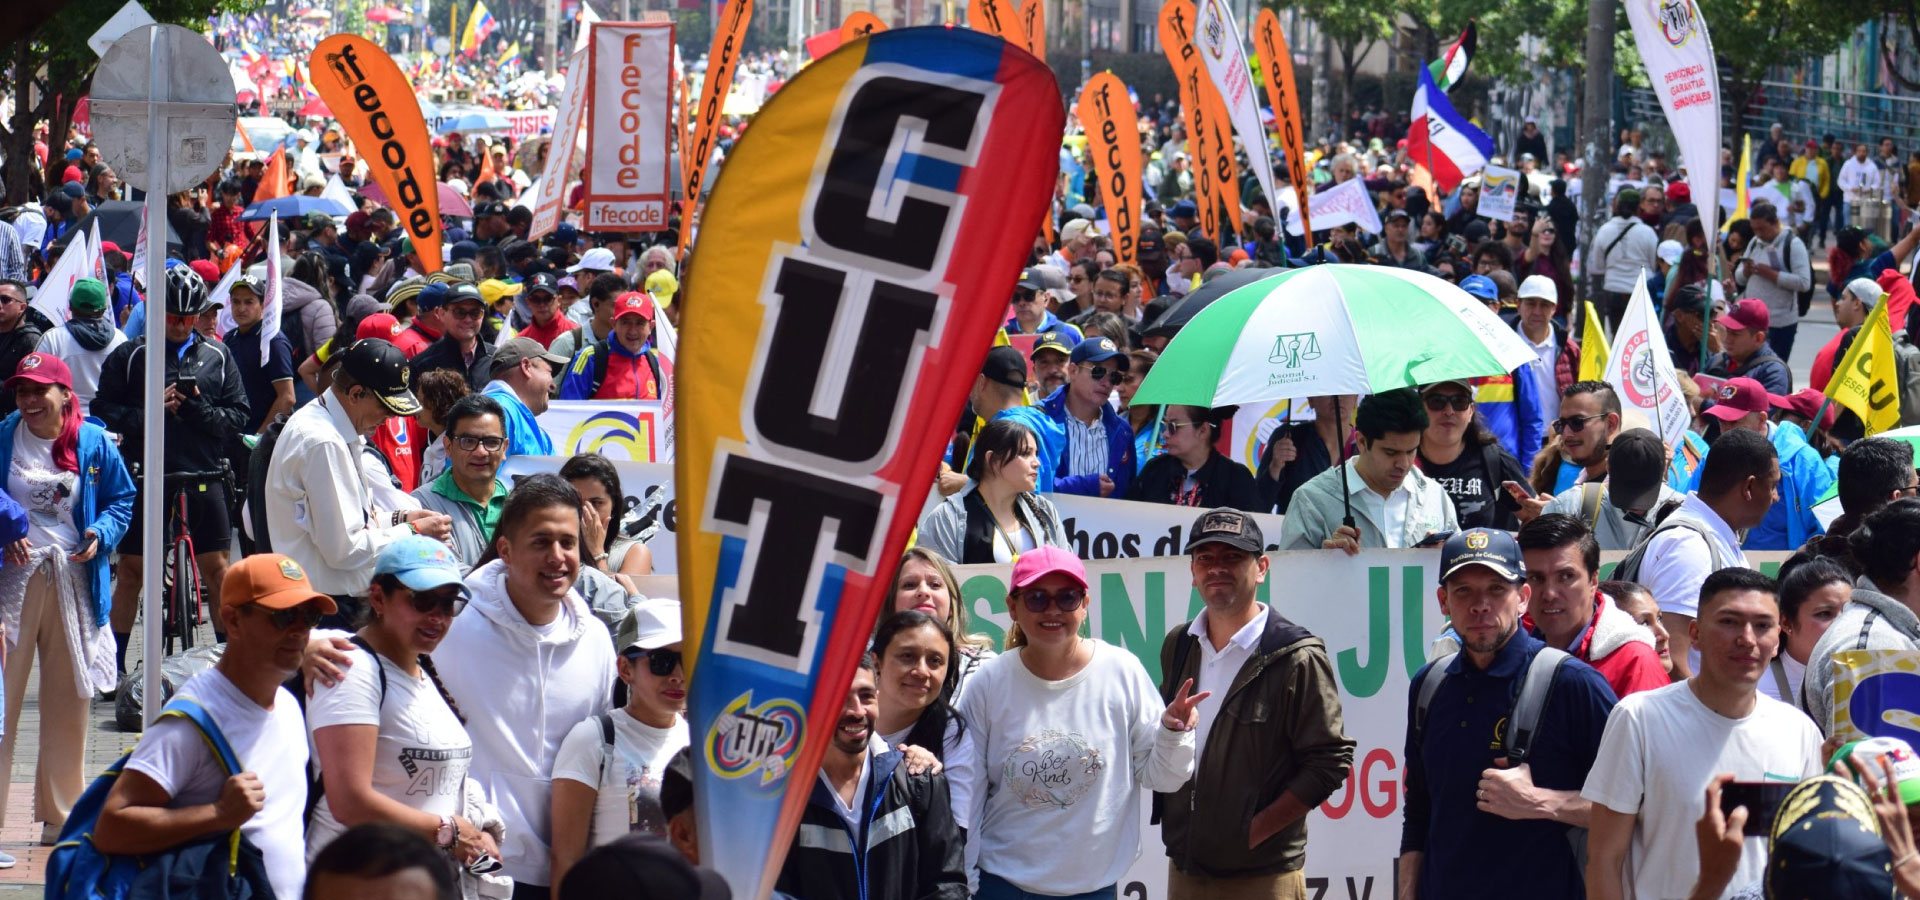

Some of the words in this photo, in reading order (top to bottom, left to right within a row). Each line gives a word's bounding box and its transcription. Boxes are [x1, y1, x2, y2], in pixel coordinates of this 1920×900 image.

[616, 33, 642, 189] fecode
[341, 44, 434, 240] fecode
[1100, 82, 1135, 262] fecode
[600, 203, 660, 224] fecode
[706, 66, 998, 670] CUT
[1266, 377, 1302, 387] Judicial
[1269, 370, 1305, 380] Asonal
[1040, 749, 1063, 770] Be
[1021, 760, 1072, 789] Kind
